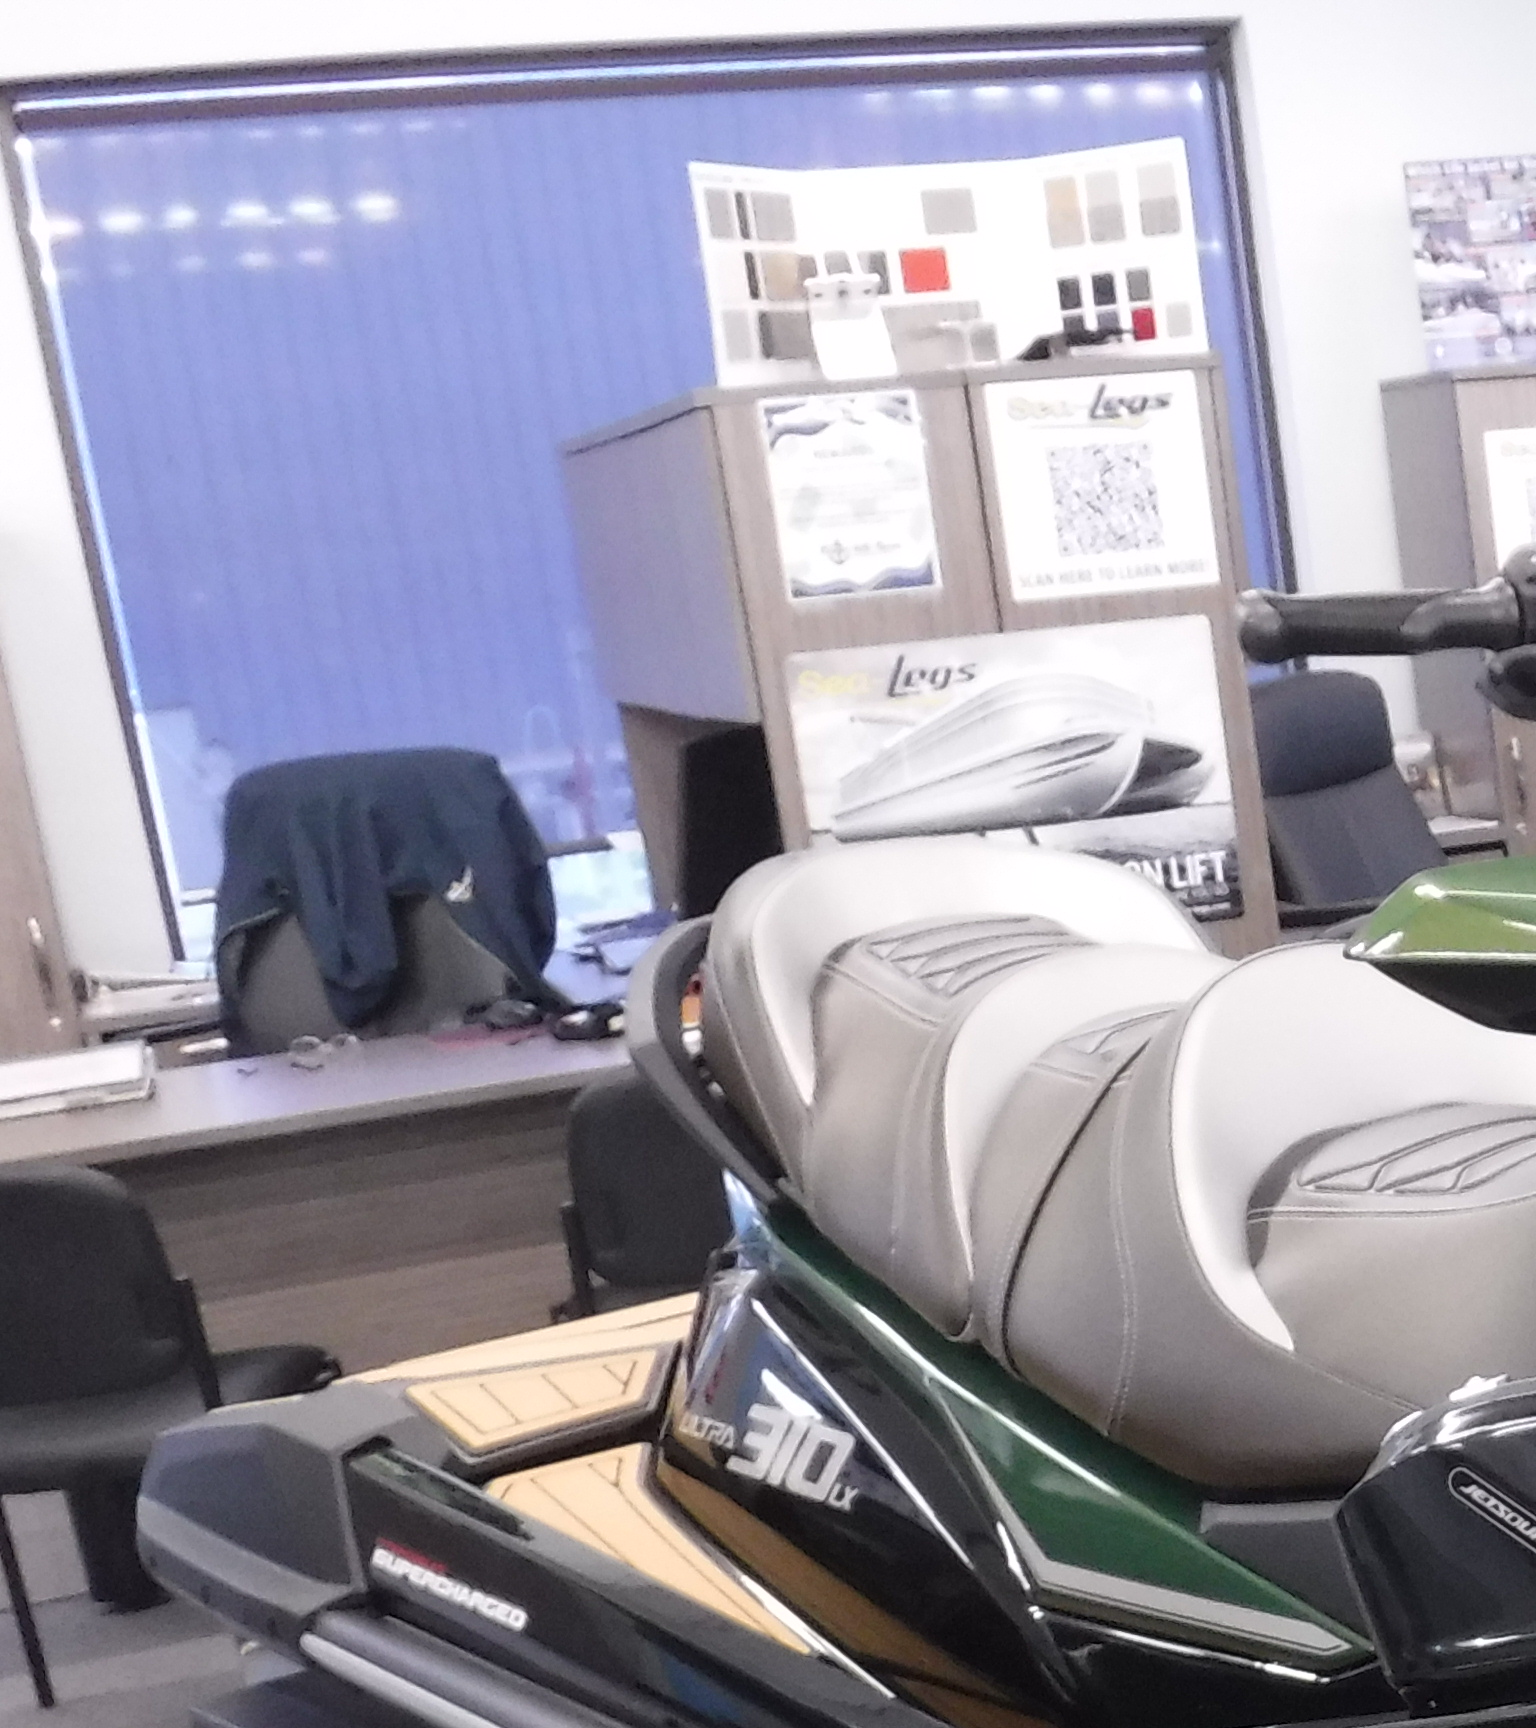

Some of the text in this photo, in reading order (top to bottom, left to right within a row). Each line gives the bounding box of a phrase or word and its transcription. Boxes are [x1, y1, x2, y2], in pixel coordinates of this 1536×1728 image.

[1119, 563, 1163, 580] LEARN
[886, 653, 978, 698] Legs
[1168, 850, 1227, 889] LIFT
[678, 1402, 860, 1512] ULTRA 310 LX
[370, 1546, 529, 1632] SUPERCHARGED
